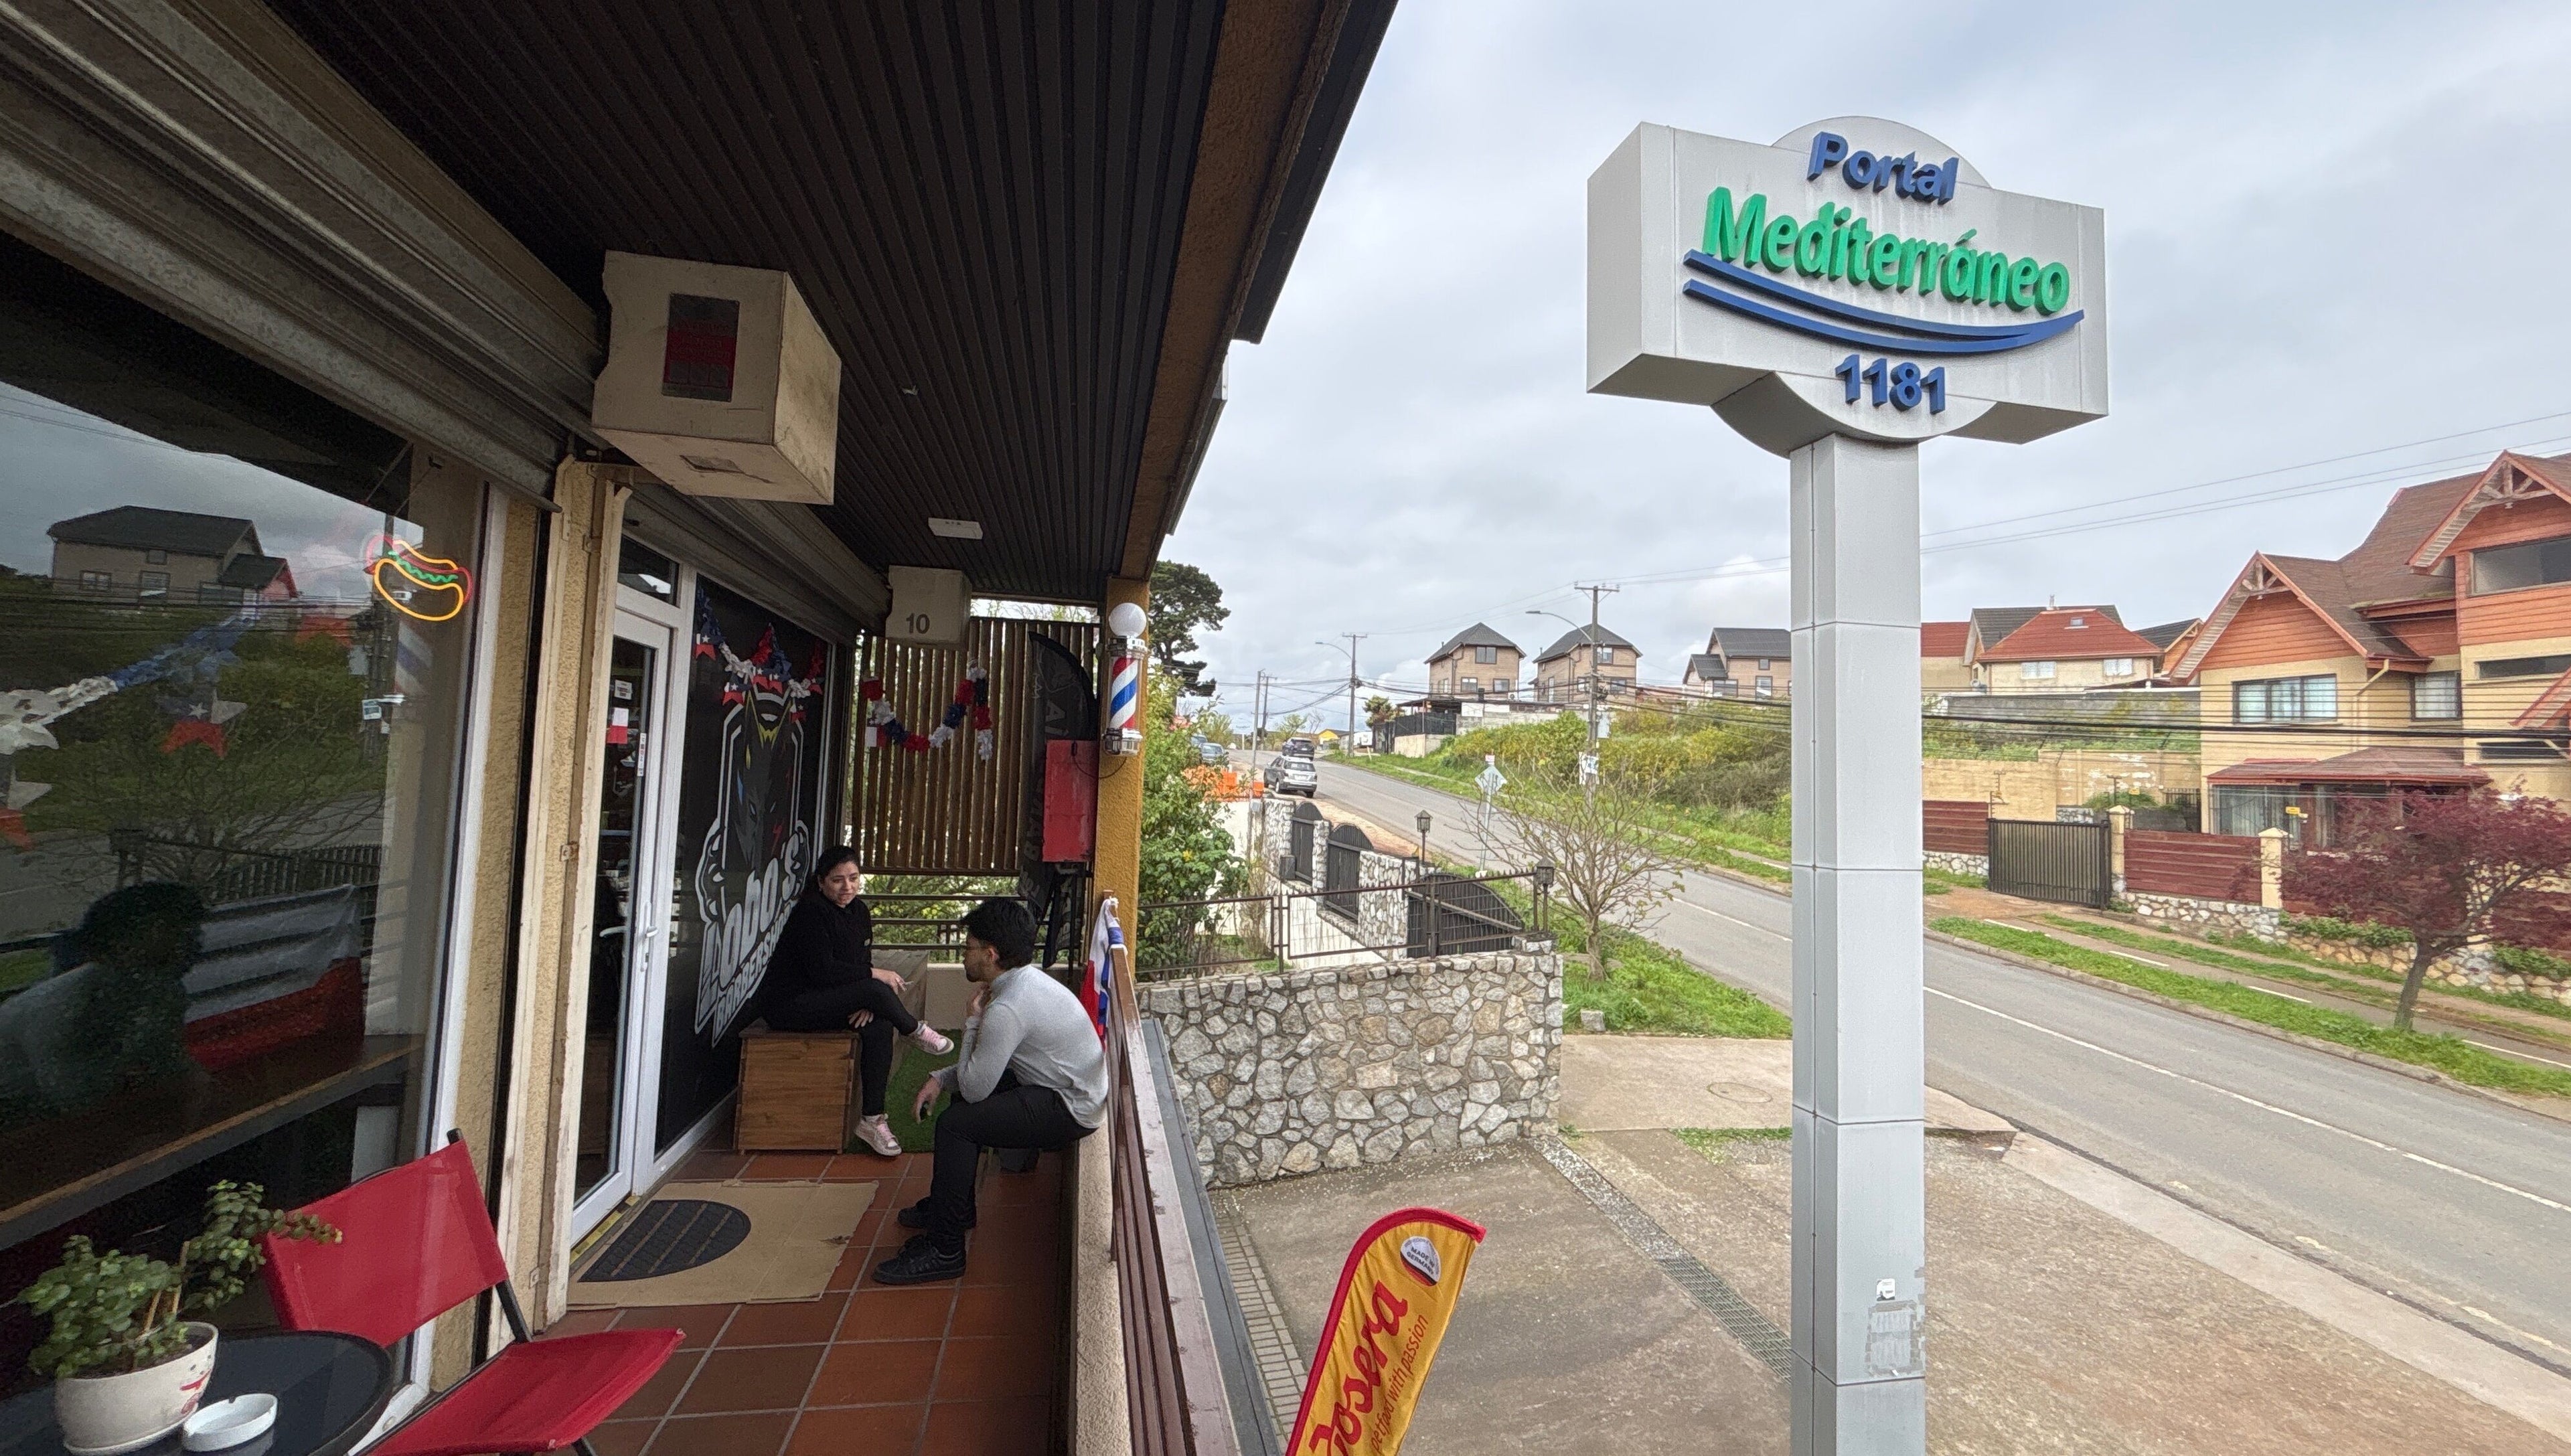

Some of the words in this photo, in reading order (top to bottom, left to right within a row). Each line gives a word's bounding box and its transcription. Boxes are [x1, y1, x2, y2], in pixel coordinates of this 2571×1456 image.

[1808, 132, 1959, 205] Portal
[1701, 186, 2070, 316] Mediterráneo
[1835, 354, 1946, 414] 1181
[906, 613, 930, 634] 10
[1407, 1251, 1434, 1275] GERMANY
[1411, 1246, 1429, 1261] MADE
[1387, 1367, 1407, 1402] with
[1400, 1314, 1429, 1376] passion
